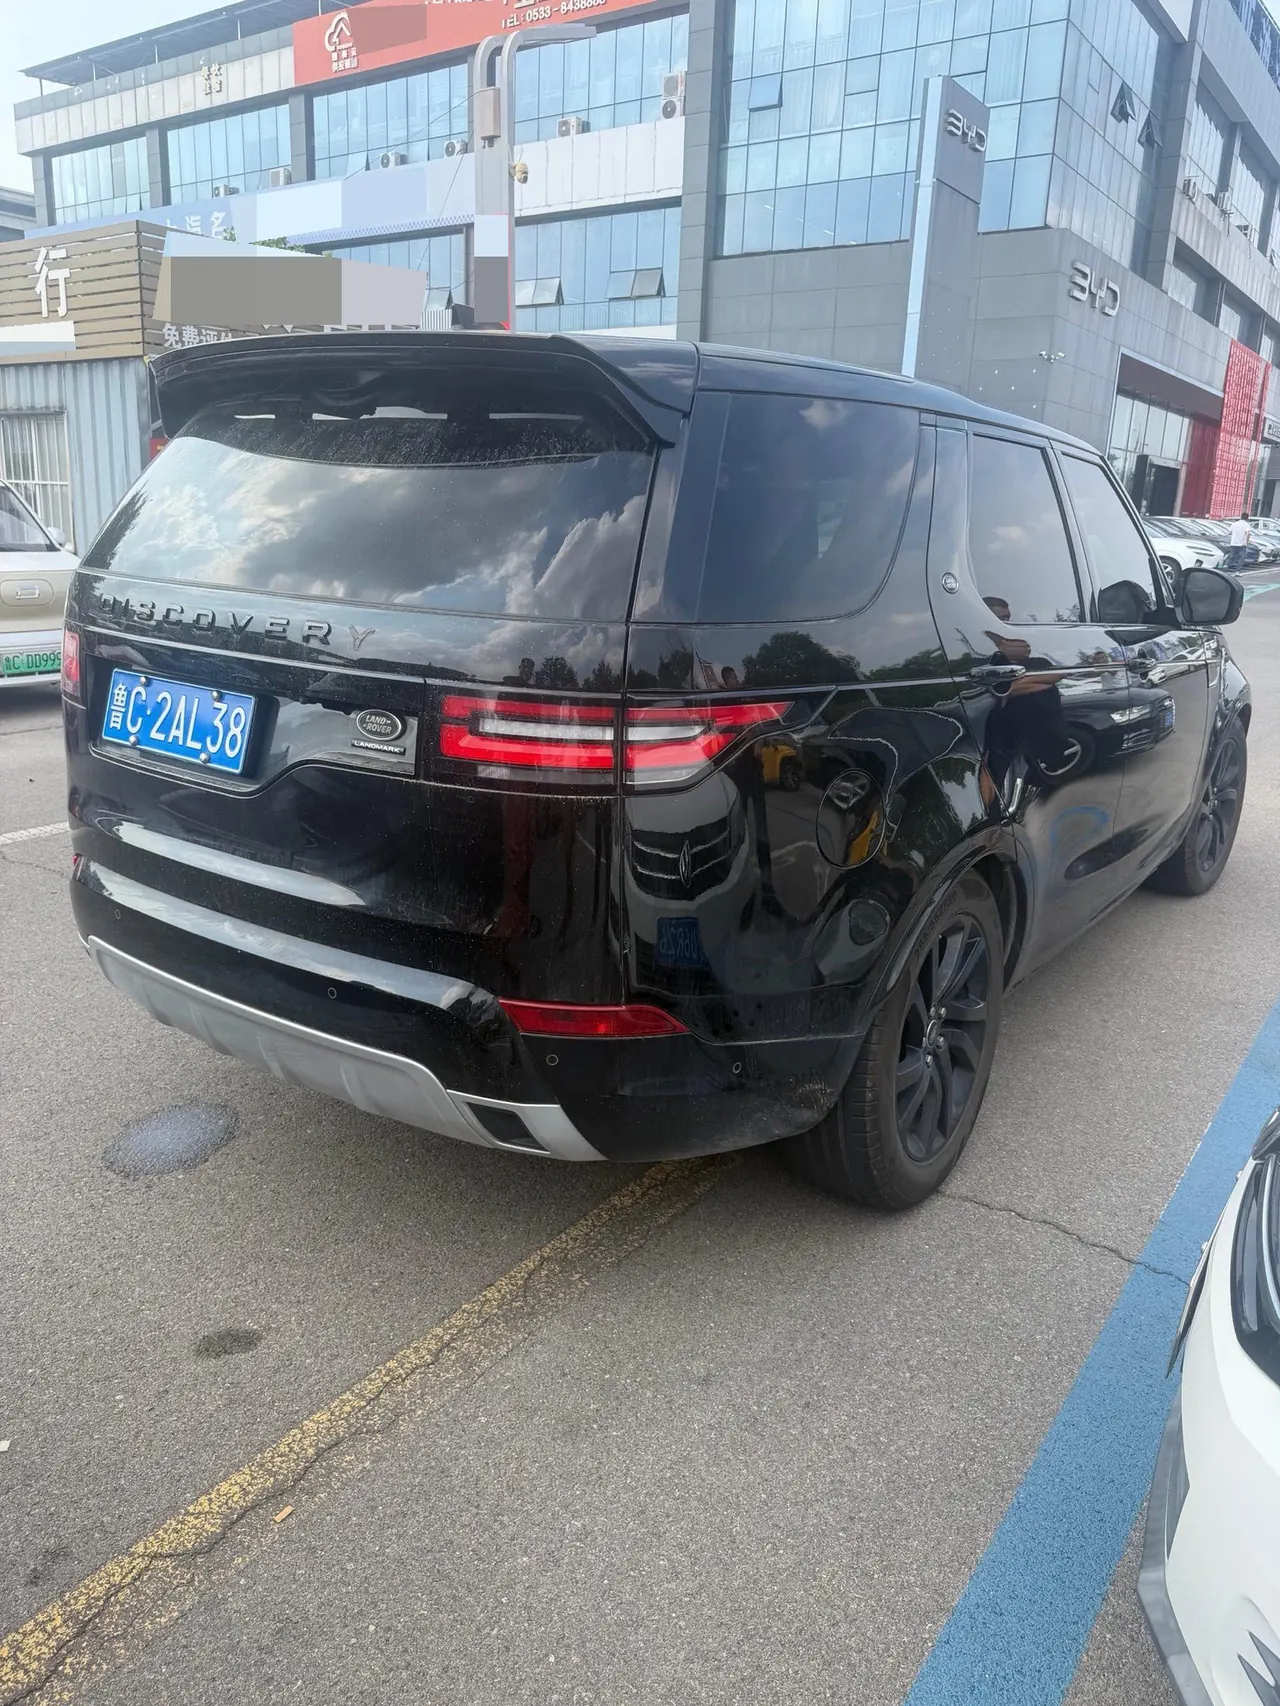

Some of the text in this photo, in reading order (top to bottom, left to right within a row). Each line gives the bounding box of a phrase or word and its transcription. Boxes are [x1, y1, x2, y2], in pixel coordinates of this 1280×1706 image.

[947, 109, 987, 151] BYD
[34, 246, 71, 318] 行
[1069, 260, 1120, 316] BYD
[99, 594, 376, 652] DISCOVERY
[354, 740, 400, 753] LANDMARK
